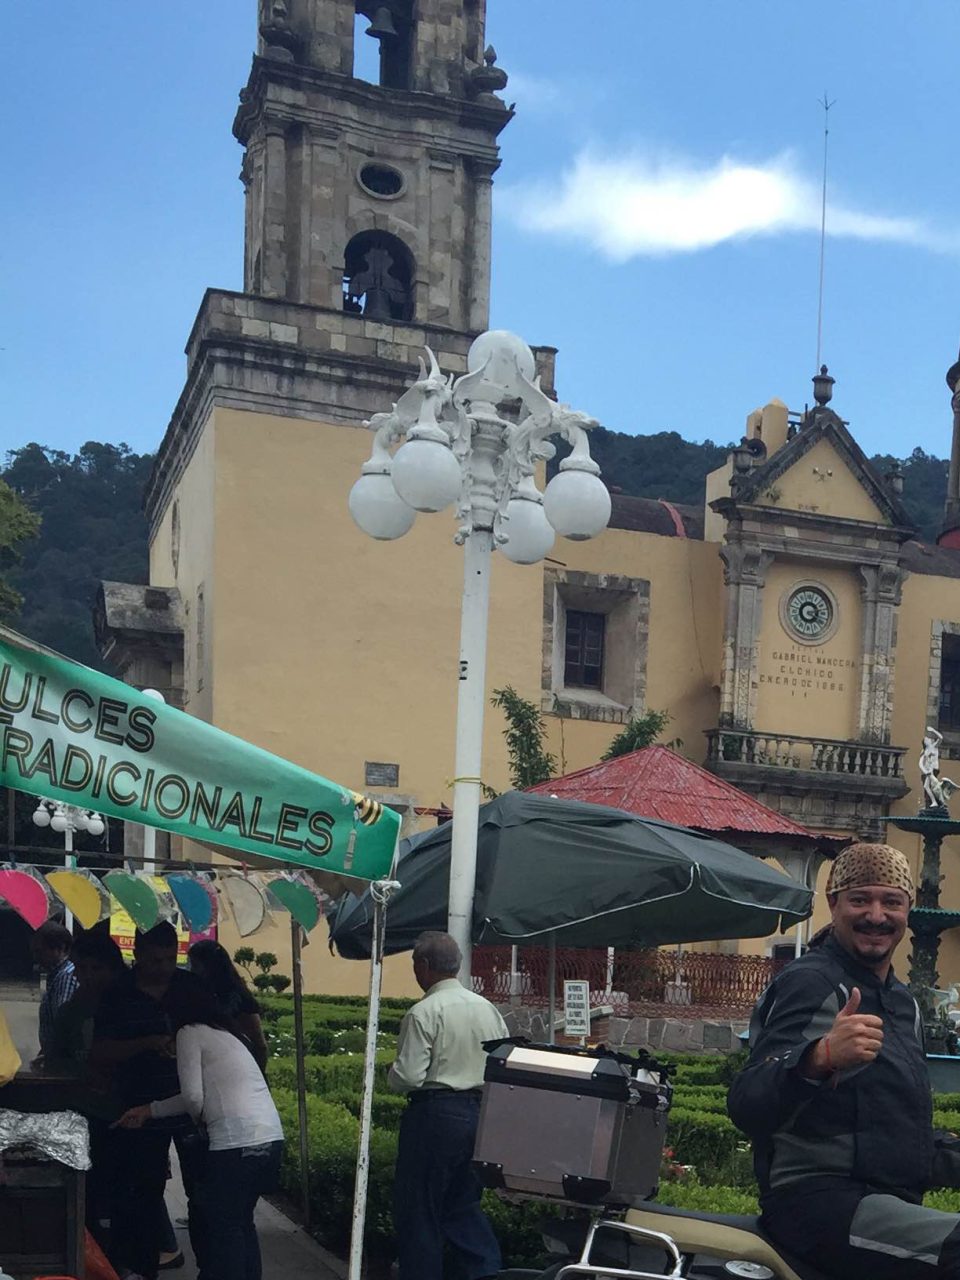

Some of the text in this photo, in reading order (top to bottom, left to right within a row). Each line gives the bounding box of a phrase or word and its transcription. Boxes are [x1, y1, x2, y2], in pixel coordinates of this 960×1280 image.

[772, 651, 856, 668] GABRIEL MANCERA
[780, 665, 833, 679] EL CHICO
[759, 674, 798, 686] ENERO
[801, 679, 812, 688] DE
[0, 662, 157, 753] ULCES
[119, 936, 135, 946] ENT
